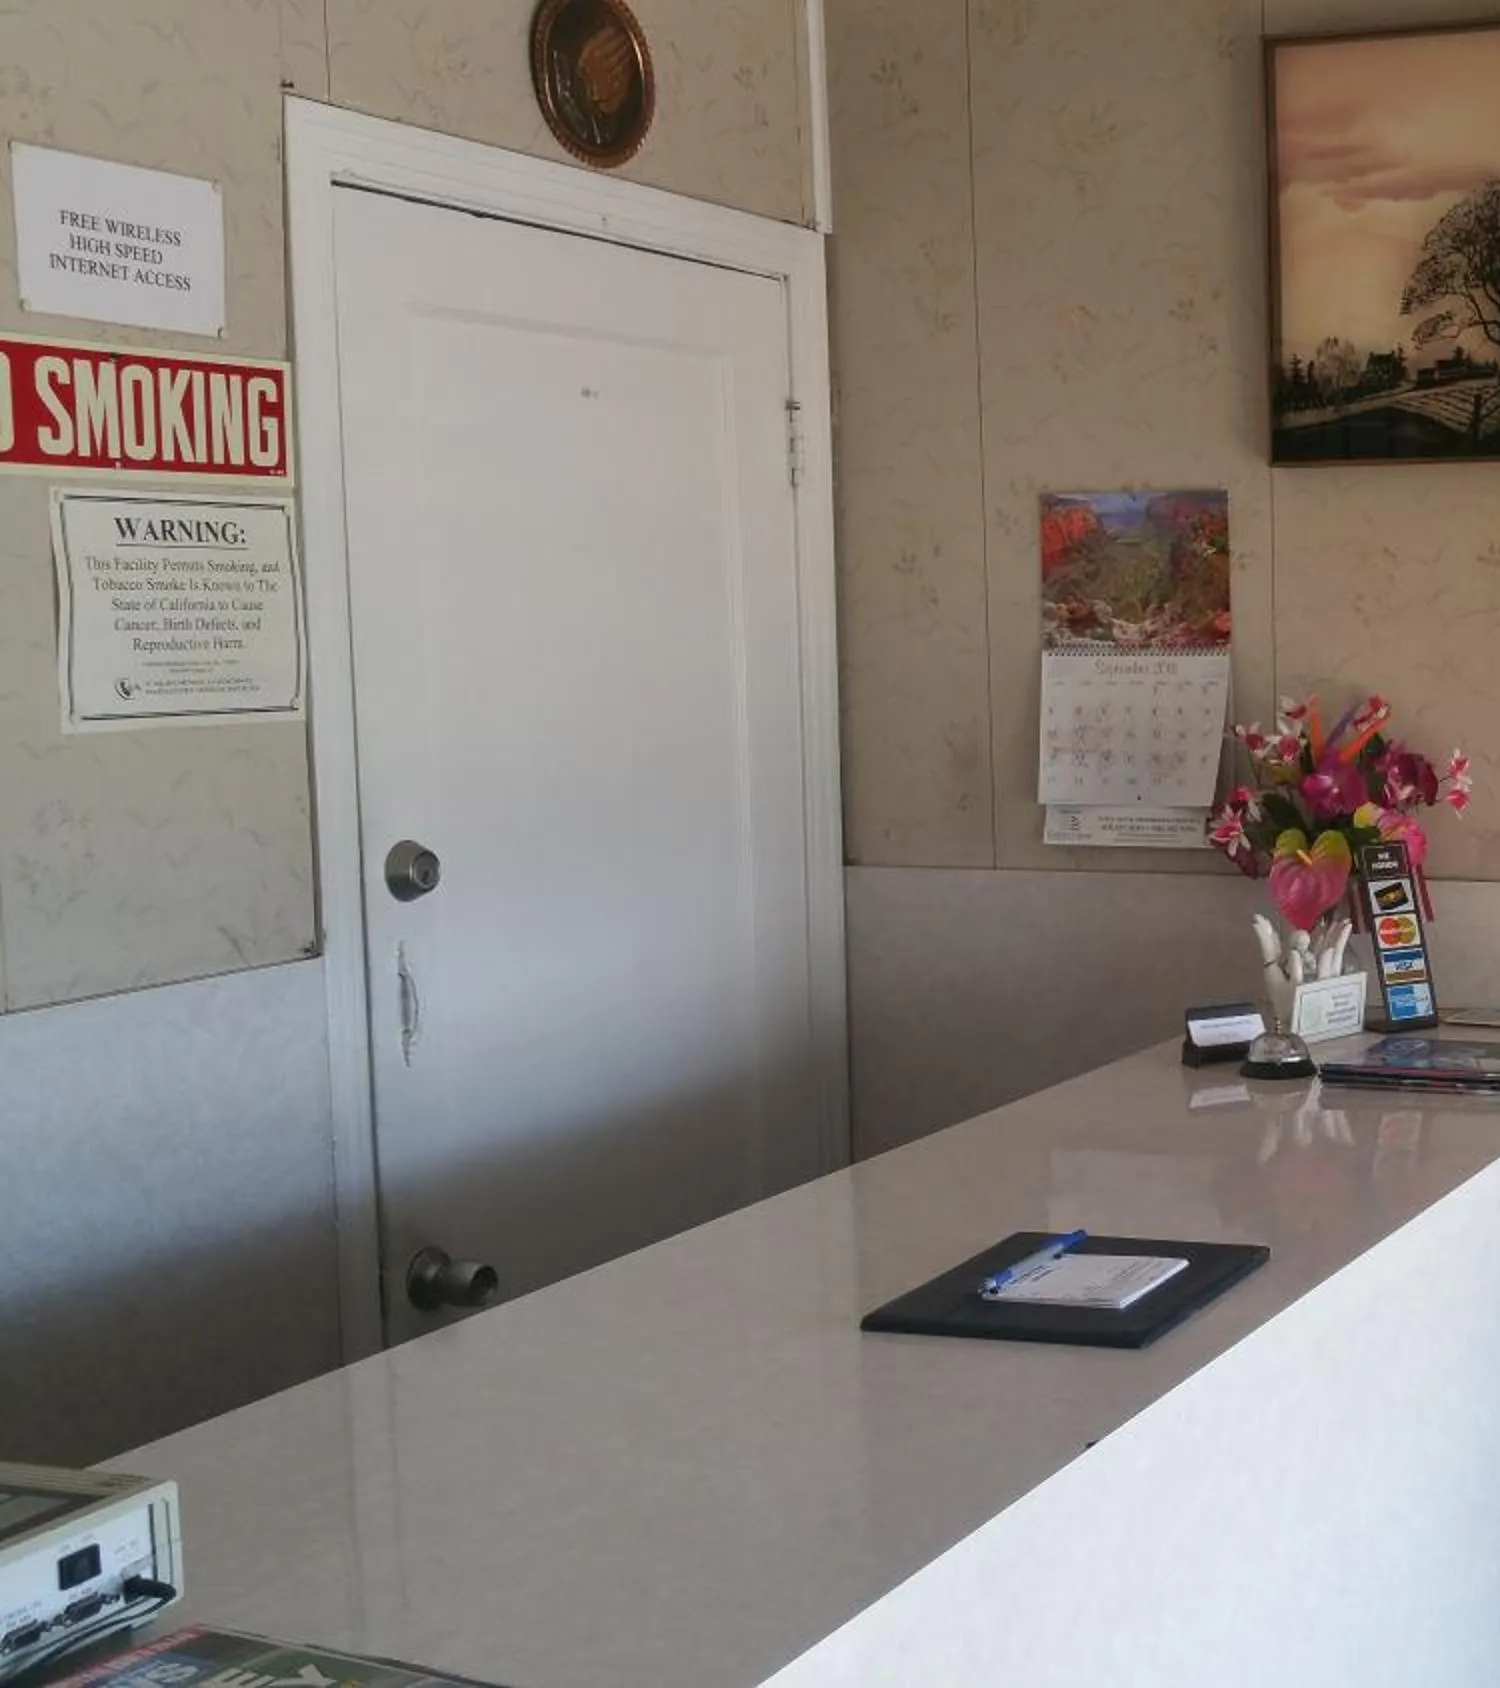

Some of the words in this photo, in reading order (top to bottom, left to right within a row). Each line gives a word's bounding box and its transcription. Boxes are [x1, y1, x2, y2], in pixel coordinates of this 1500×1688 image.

[59, 209, 101, 231] FREE
[105, 218, 182, 247] WIRELESS
[69, 232, 111, 256] HIGH
[114, 243, 163, 265] SPEED
[49, 253, 129, 281] INTERNET
[133, 267, 191, 291] ACCESS
[33, 355, 280, 467] SMOKING
[114, 517, 247, 545] WARNING:
[84, 556, 111, 571] This
[113, 557, 159, 575] Facility
[93, 576, 144, 591] Tobacco
[146, 578, 187, 591] Smoke
[256, 579, 280, 593] The
[111, 597, 142, 612] State
[159, 597, 215, 613] California
[162, 617, 193, 632] Birth
[132, 637, 211, 655] Reproductive
